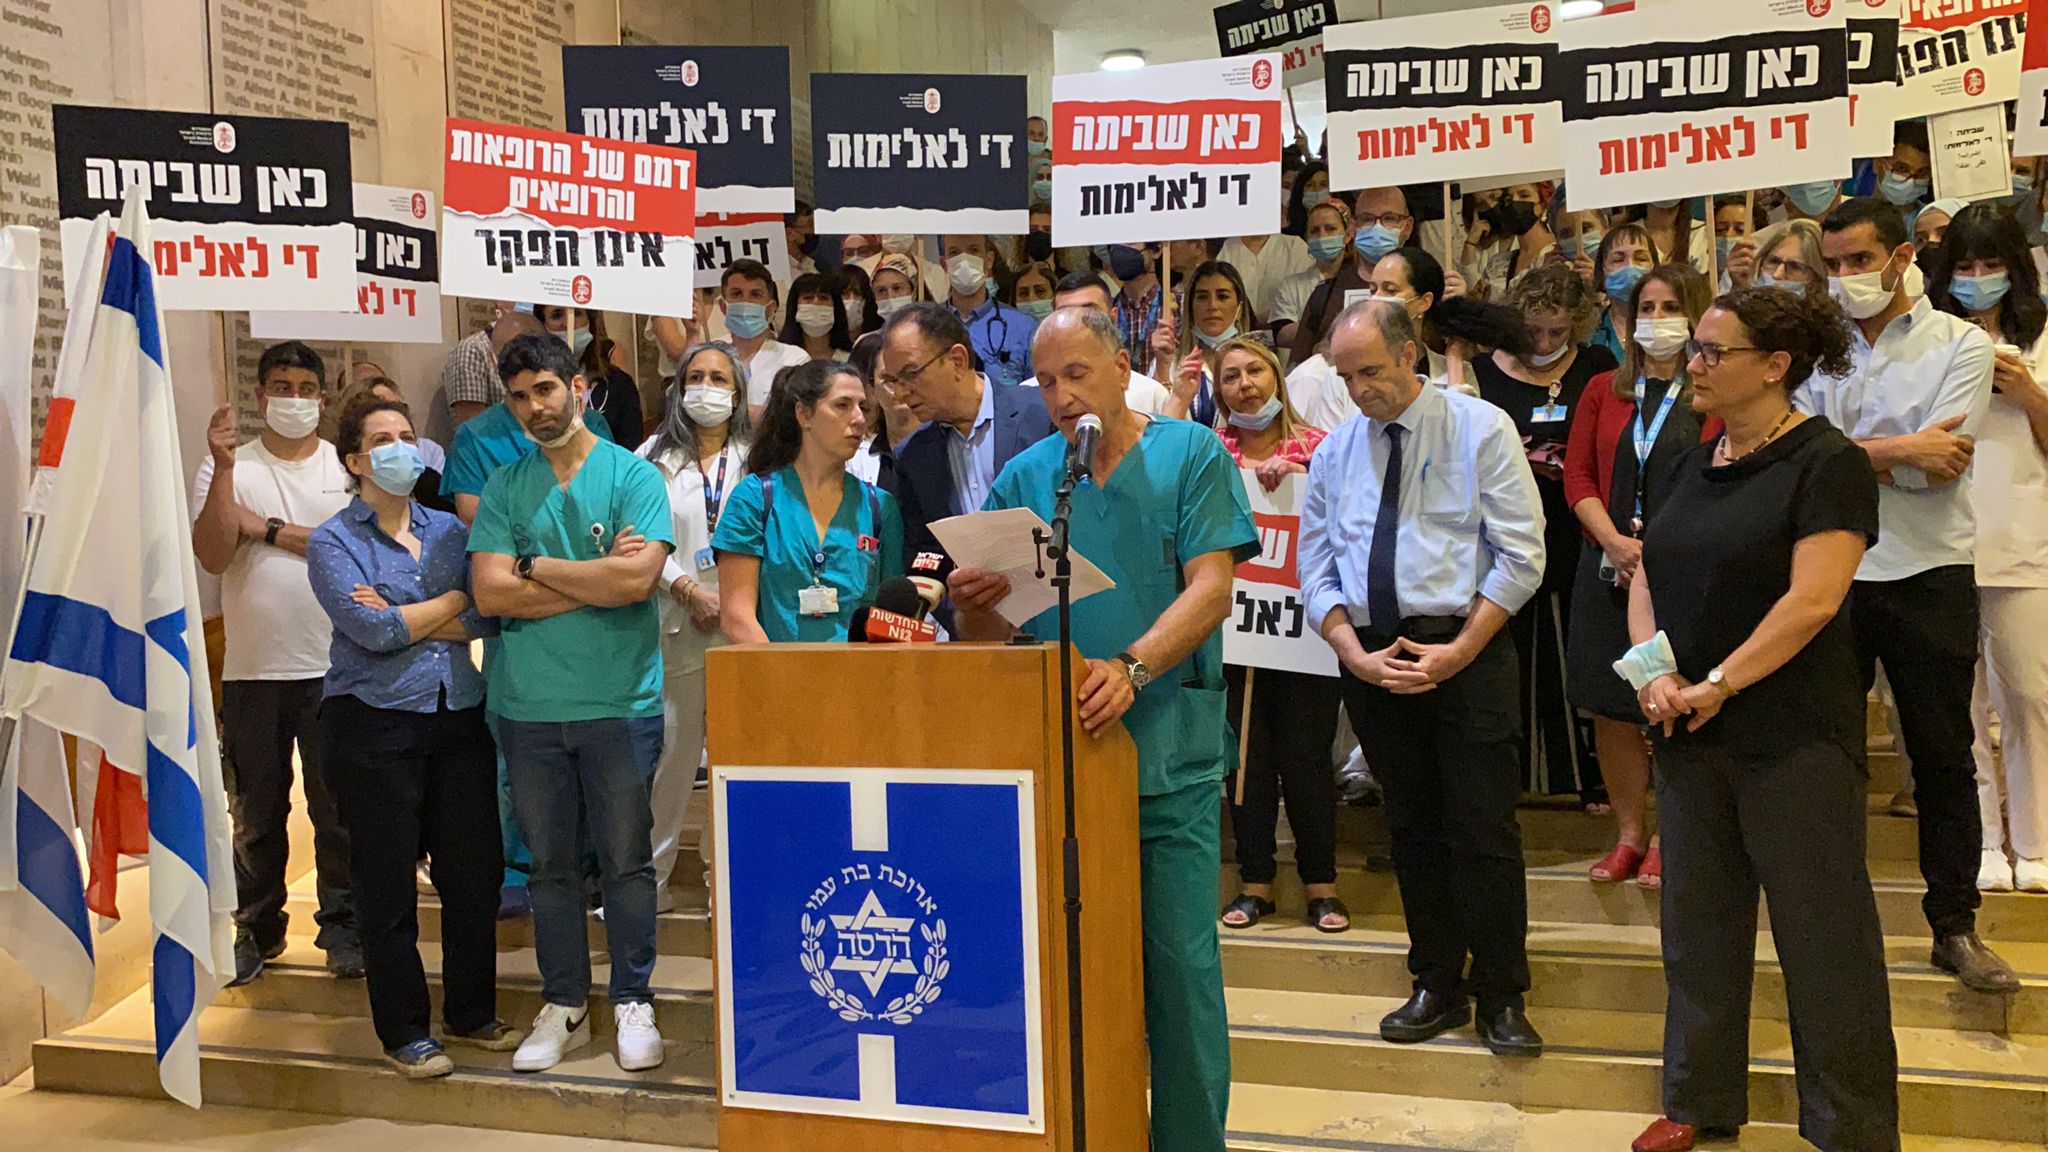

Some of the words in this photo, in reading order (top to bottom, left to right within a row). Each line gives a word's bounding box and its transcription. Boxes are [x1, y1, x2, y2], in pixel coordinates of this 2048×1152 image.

[1227, 11, 1290, 49] שביתה
[1294, 2, 1327, 29] כאן
[1347, 58, 1469, 98] שביתה
[1482, 55, 1543, 98] כאן
[1586, 52, 1730, 104] שביתה
[1745, 44, 1820, 98] כאן
[581, 101, 729, 144] לאלימות
[741, 108, 776, 145] די
[1071, 114, 1190, 151] שביתה
[1200, 113, 1261, 157] כאן
[1357, 112, 1491, 161] לאלימות
[1502, 112, 1535, 144] די
[1770, 112, 1810, 150] די
[450, 129, 572, 175] הרופאות
[581, 140, 625, 182] של
[827, 127, 969, 169] לאלימות
[980, 134, 1014, 169] די
[1598, 114, 1755, 176] לאלימות
[85, 157, 242, 204] שביתה
[256, 166, 328, 213] כאן
[634, 153, 691, 190] דמם
[1219, 173, 1251, 206] די
[509, 175, 635, 222] והרופאים
[1080, 171, 1207, 217] לאלימות
[153, 235, 269, 278] לאלימ
[283, 244, 320, 279] די
[376, 231, 421, 270] כאן
[474, 229, 581, 274] הפקר
[592, 230, 666, 268] אינו
[742, 238, 770, 265] די
[392, 288, 416, 316] די
[870, 608, 919, 631] החדשות
[888, 624, 913, 642] N12
[805, 876, 837, 910] עמי
[841, 863, 871, 884] בת
[877, 864, 937, 915] ארוכת
[837, 930, 911, 959] הדסה
